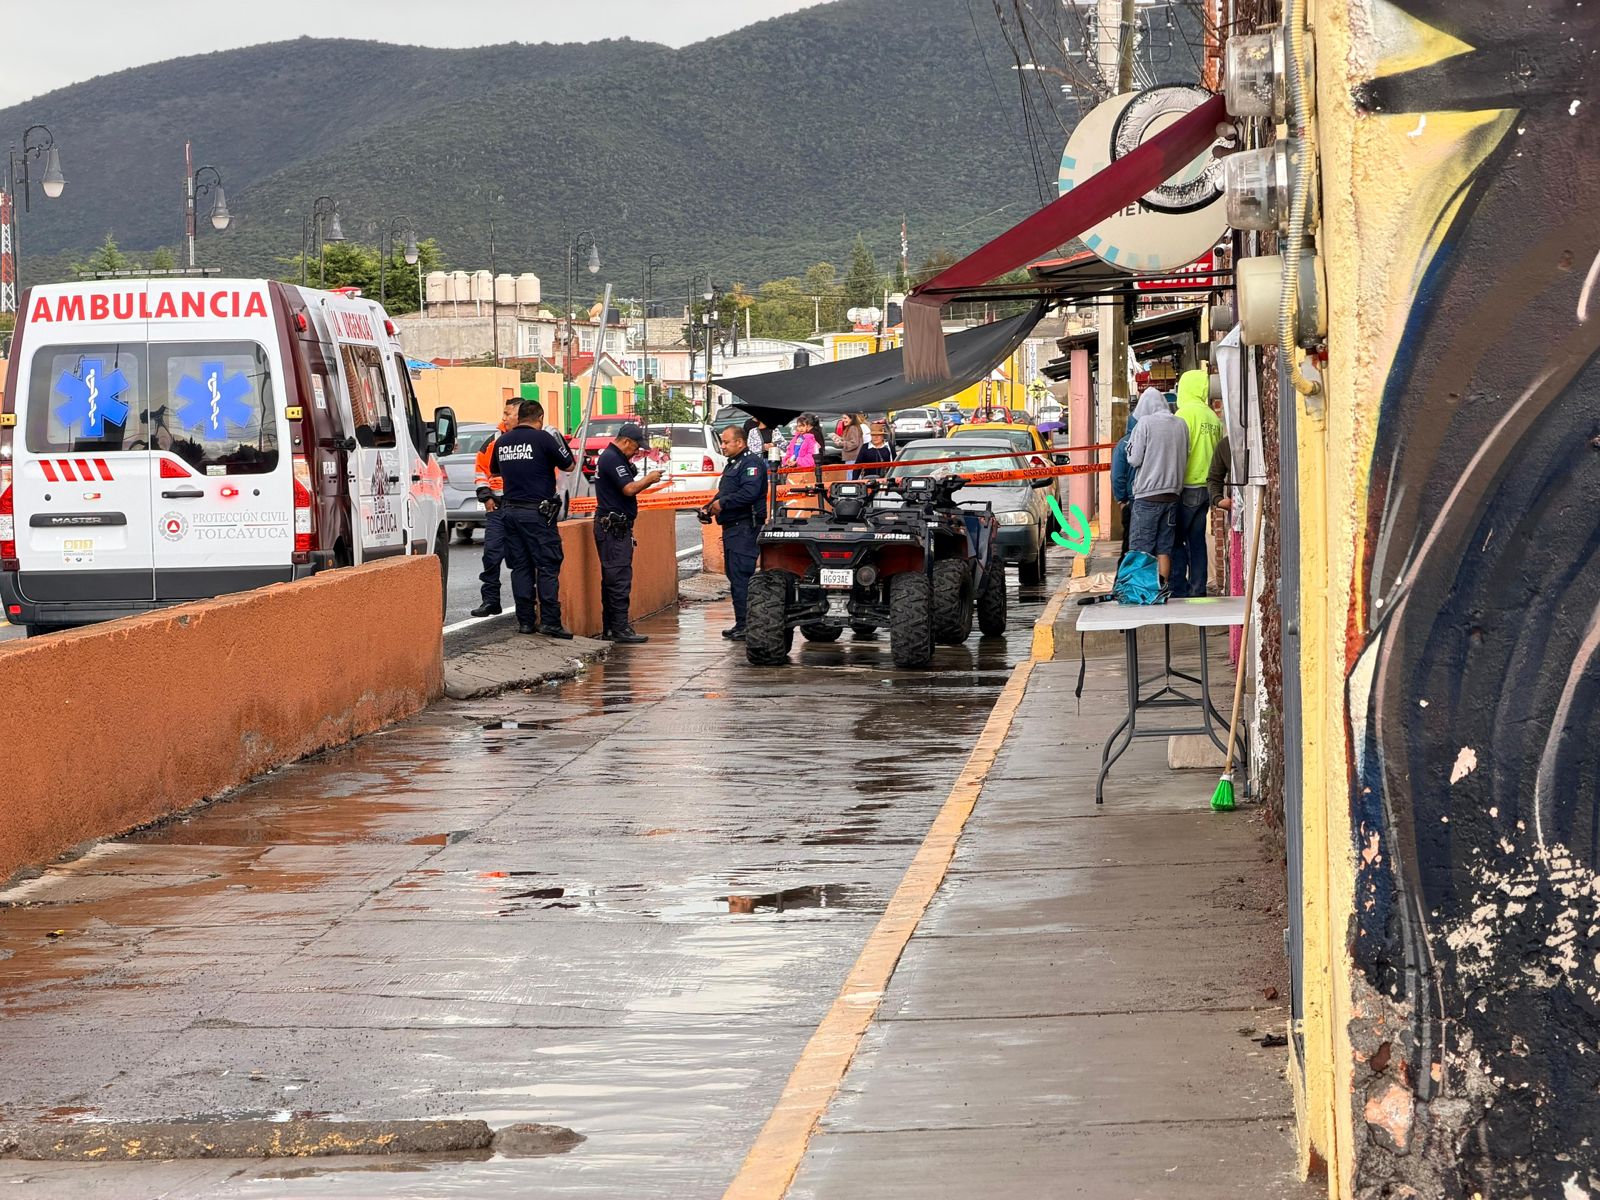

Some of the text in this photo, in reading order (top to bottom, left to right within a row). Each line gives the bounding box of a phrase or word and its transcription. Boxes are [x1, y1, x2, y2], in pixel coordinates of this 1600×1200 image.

[31, 291, 268, 323] AMBULANCIA
[498, 442, 533, 455] POLICÍA
[498, 452, 534, 462] MUNICIPAL
[51, 517, 102, 525] MASTER
[192, 509, 289, 524] PROTECCIÓN CIVIL
[194, 527, 289, 541] TOLCAYUCA
